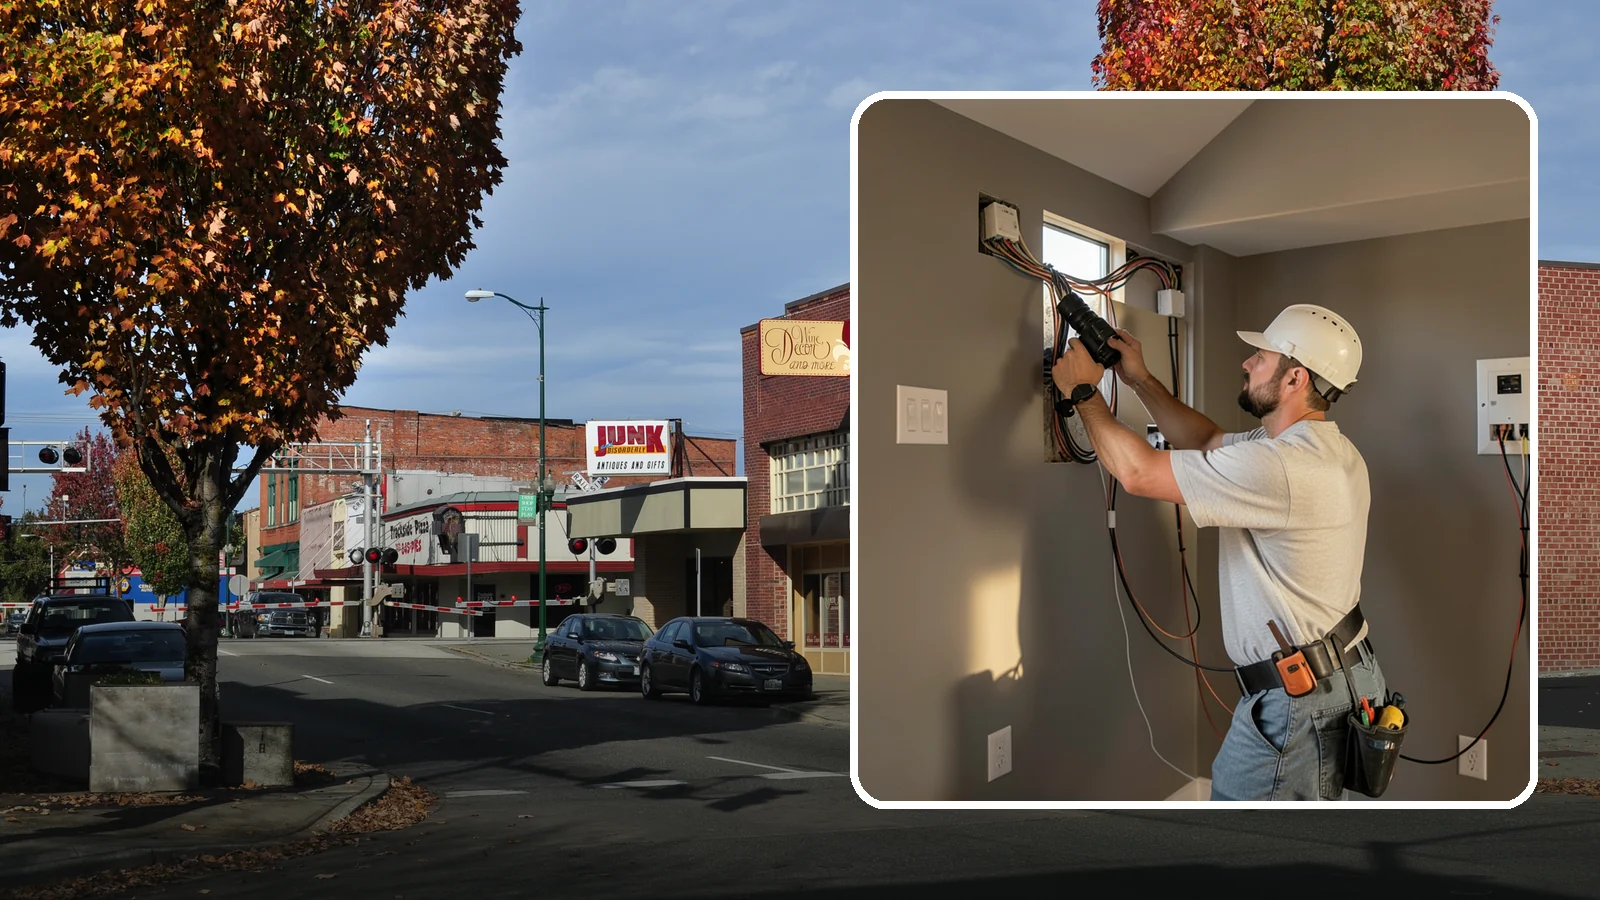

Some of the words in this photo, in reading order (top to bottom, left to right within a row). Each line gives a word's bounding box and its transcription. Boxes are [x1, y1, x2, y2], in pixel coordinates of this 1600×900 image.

[595, 425, 666, 457] JUNK
[607, 446, 646, 454] DISORDERLY
[597, 461, 628, 470] ANTIQUES
[631, 461, 644, 470] AND
[647, 460, 665, 470] GIFTS
[573, 473, 589, 492] RAIL
[352, 498, 364, 511] CRO
